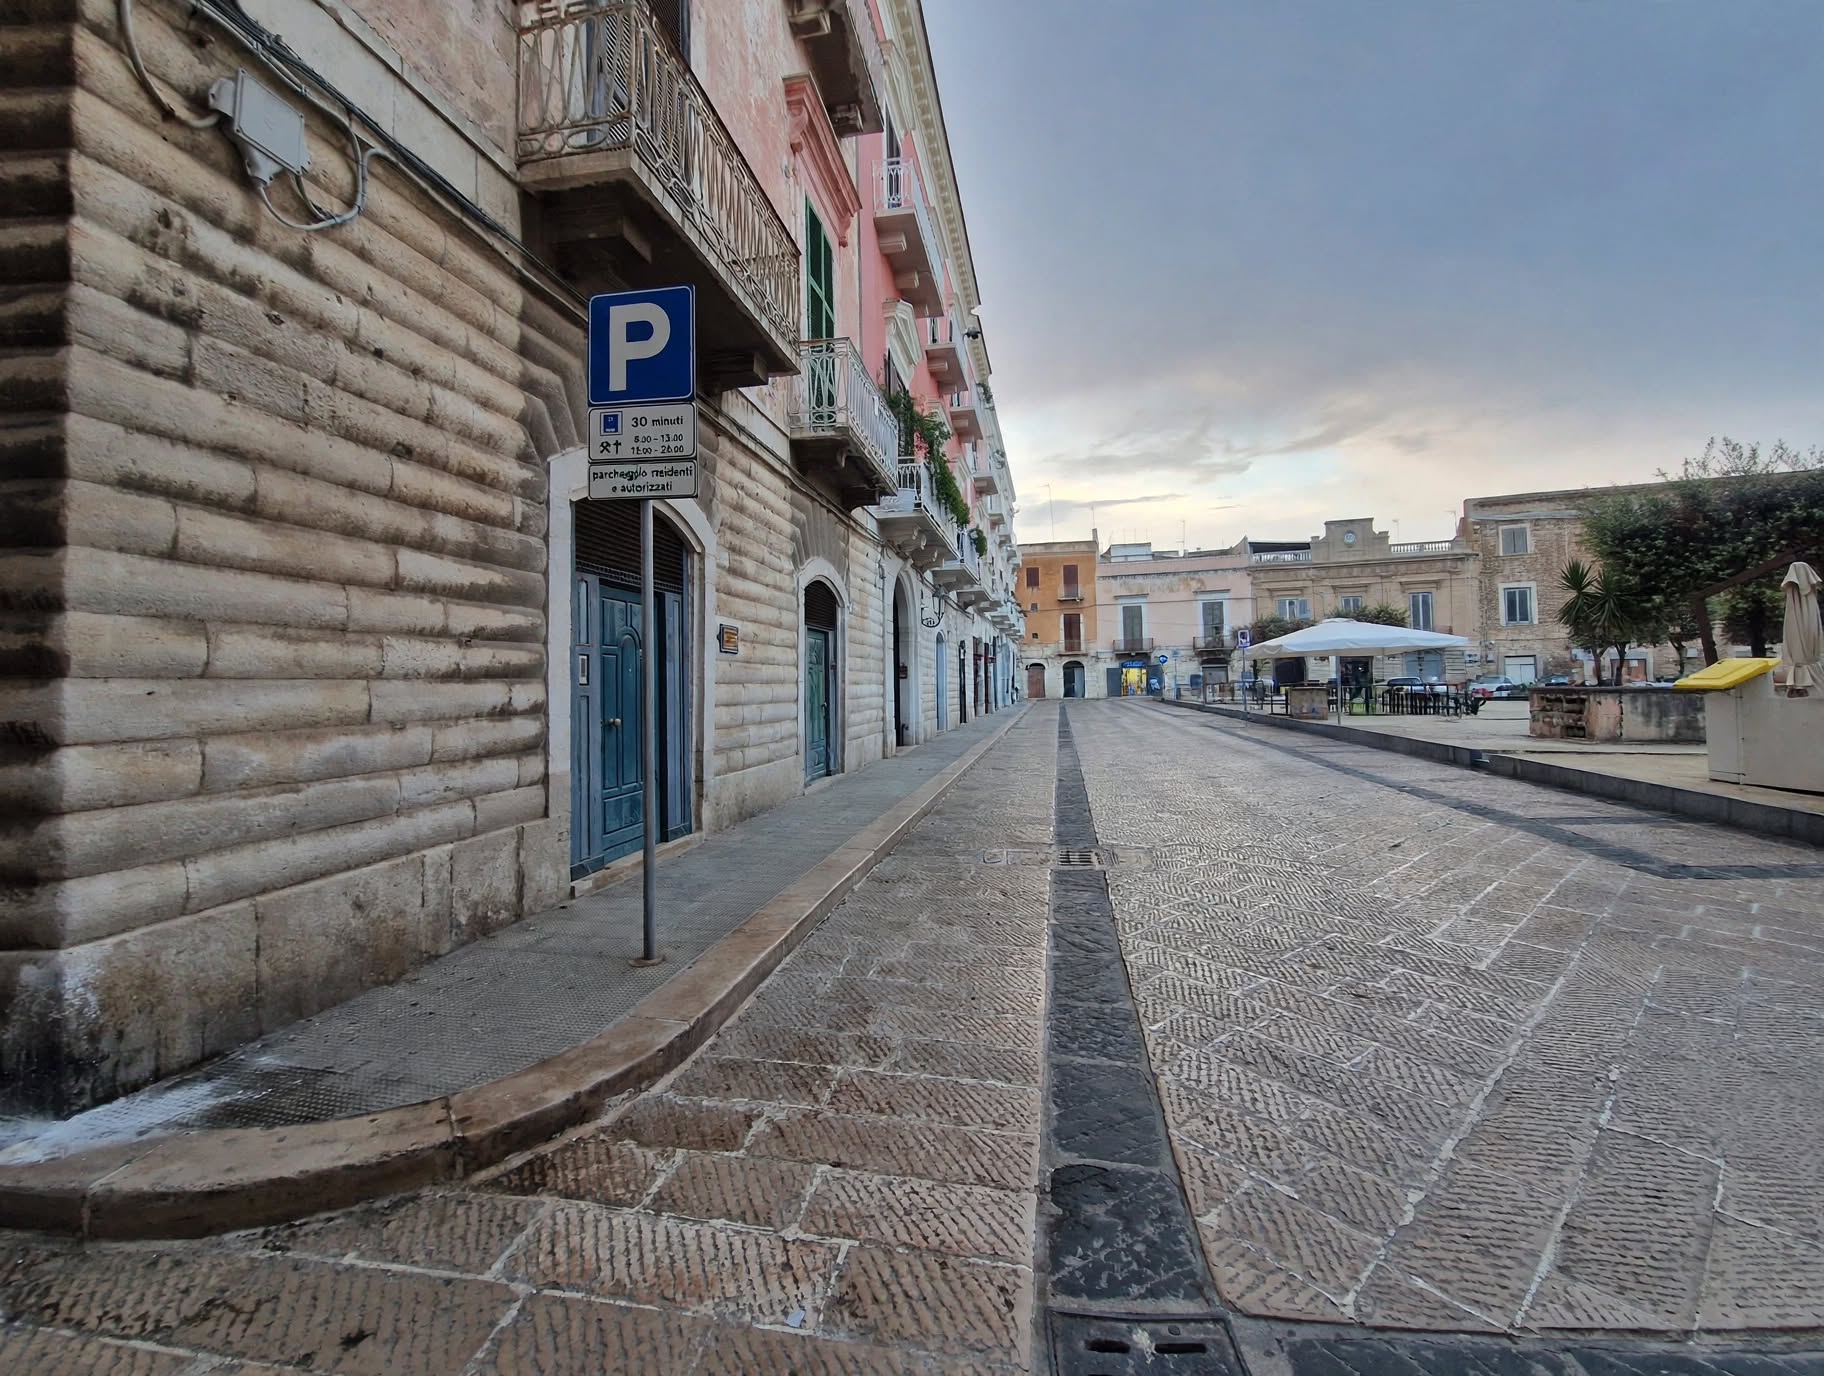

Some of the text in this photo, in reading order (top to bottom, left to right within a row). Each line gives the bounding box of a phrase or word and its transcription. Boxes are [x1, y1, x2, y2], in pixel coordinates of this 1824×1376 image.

[609, 303, 671, 392] P
[632, 415, 684, 428] 30 minuti
[611, 481, 673, 493] e autorizzati
